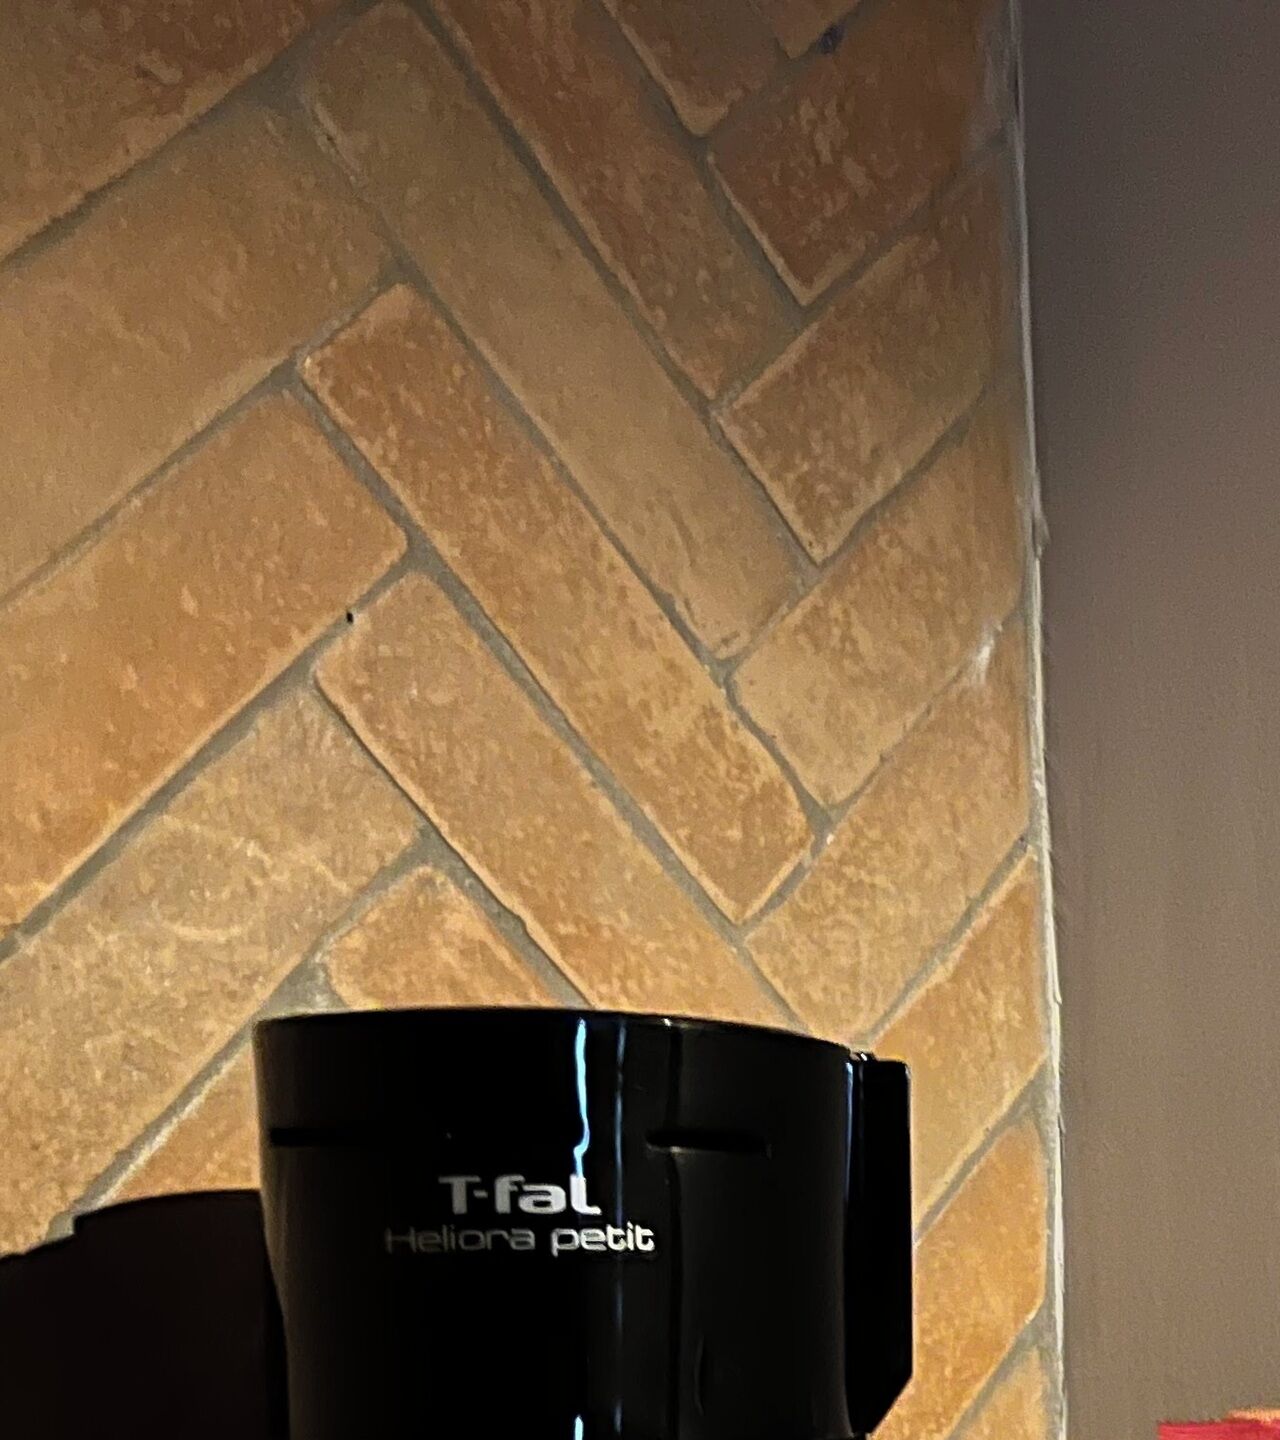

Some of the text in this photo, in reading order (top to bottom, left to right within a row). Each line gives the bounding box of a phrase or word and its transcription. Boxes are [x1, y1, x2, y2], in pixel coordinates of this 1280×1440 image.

[438, 1173, 602, 1216] T-fal
[385, 1221, 656, 1258] Heliora petit
